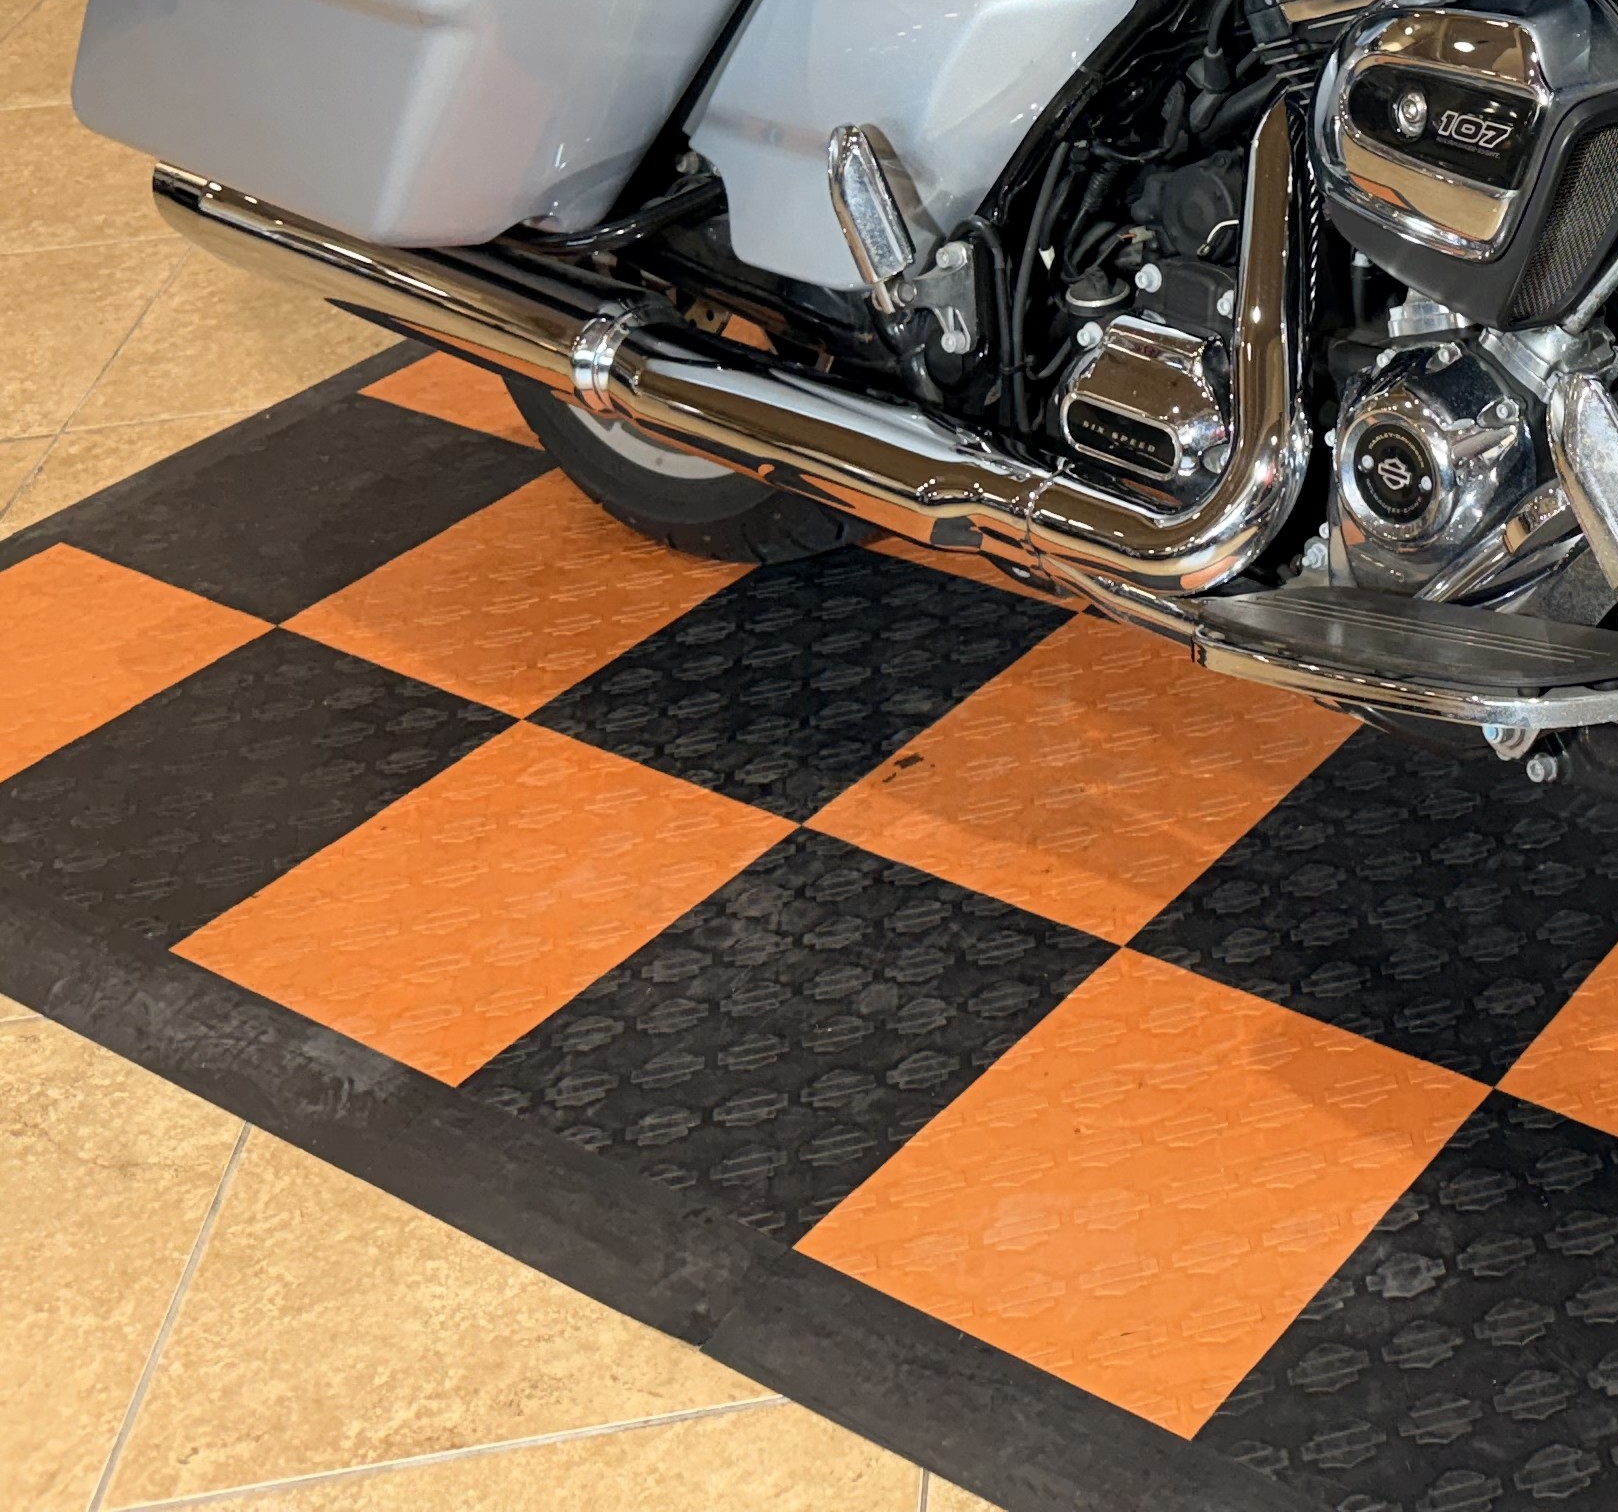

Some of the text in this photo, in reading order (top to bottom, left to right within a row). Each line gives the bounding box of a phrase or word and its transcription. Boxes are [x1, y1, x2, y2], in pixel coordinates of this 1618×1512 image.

[1438, 110, 1514, 149] 107
[1081, 419, 1156, 453] SIX SPEED
